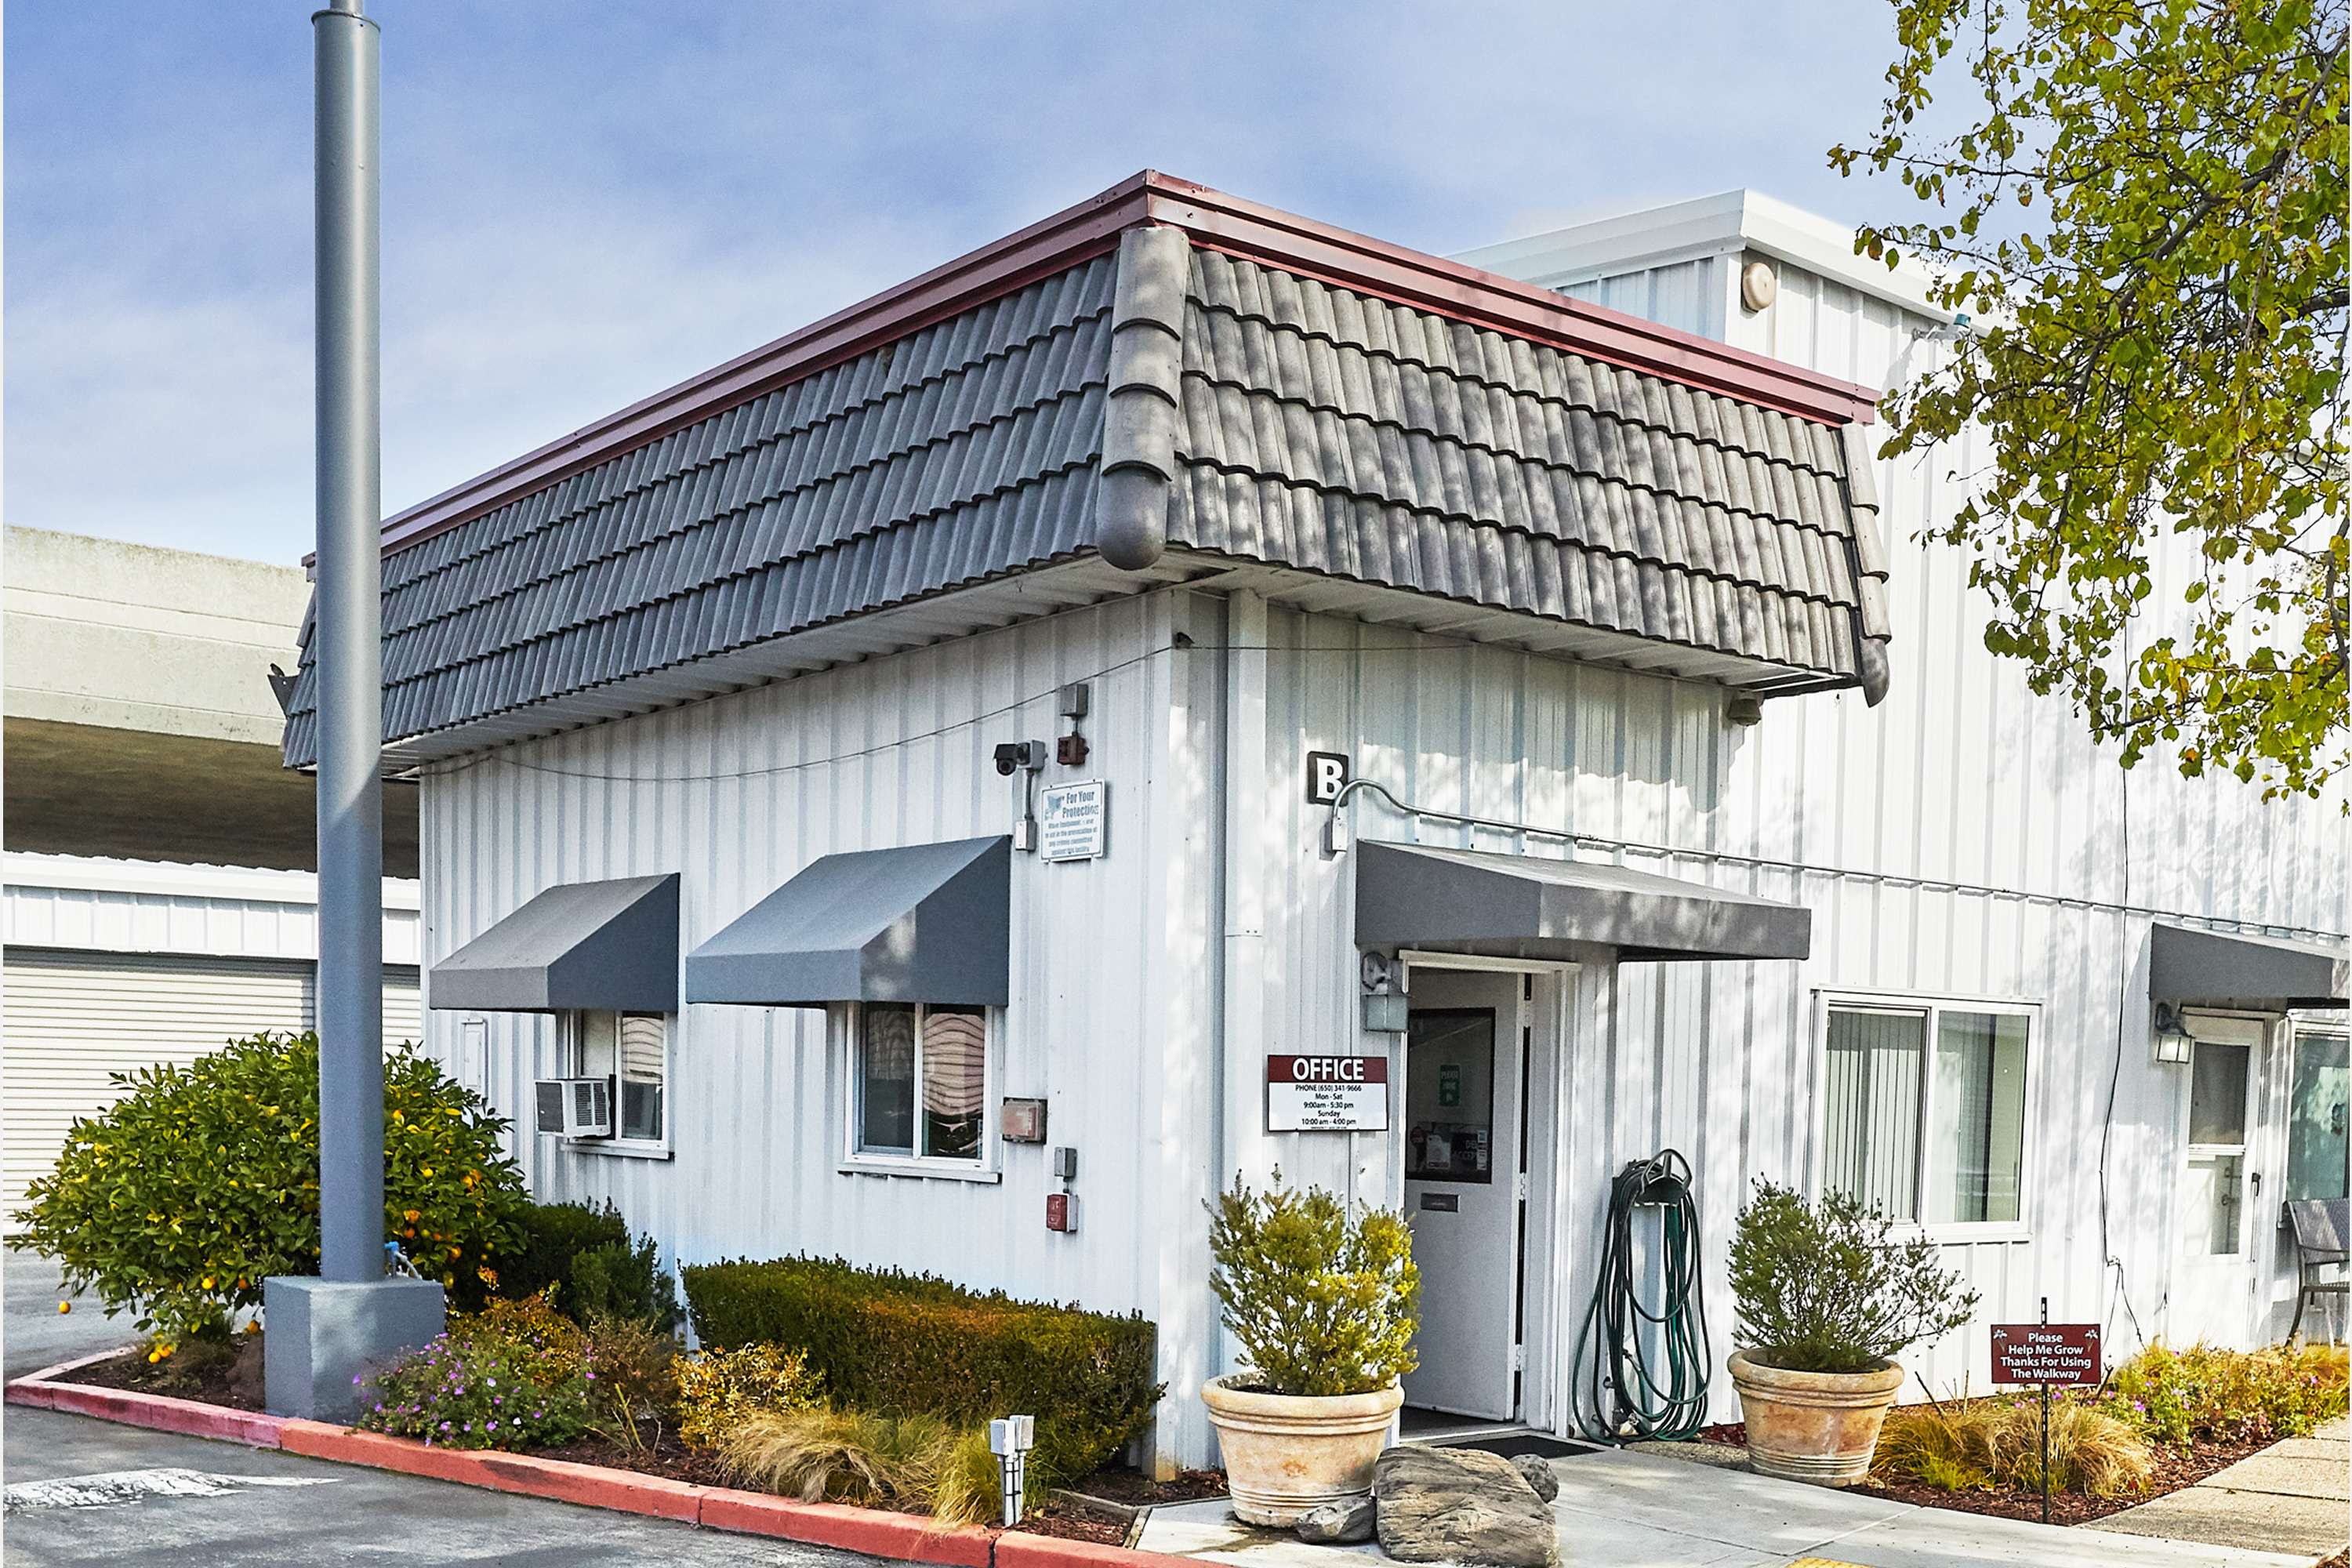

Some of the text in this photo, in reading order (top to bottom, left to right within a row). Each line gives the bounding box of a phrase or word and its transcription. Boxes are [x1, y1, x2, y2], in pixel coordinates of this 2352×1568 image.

[1316, 757, 1343, 800] B
[1067, 790, 1095, 804] For Your
[1292, 1058, 1365, 1081] OFFICE
[2028, 1333, 2063, 1343] Please
[2008, 1345, 2084, 1357] Help Me Grow
[2001, 1357, 2092, 1369] Thanks For Using
[2011, 1369, 2082, 1381] The Walkway
